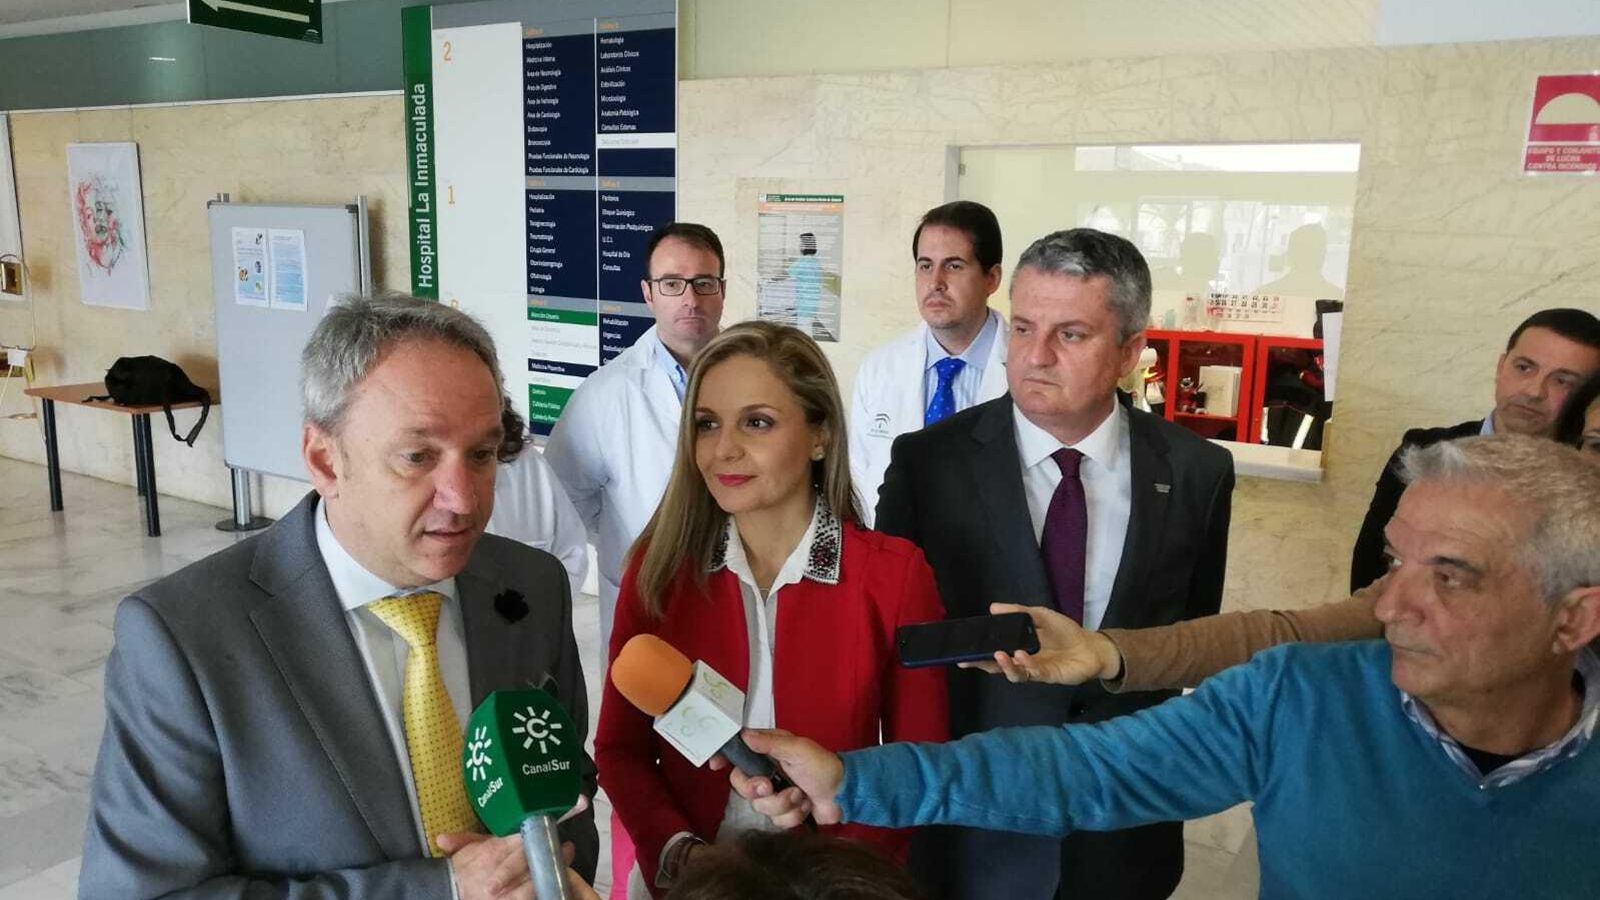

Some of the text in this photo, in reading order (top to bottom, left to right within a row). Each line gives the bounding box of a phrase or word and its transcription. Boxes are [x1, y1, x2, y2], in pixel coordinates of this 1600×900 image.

[443, 41, 452, 62] 2
[412, 83, 434, 288] Hospital La Inmaculada
[448, 184, 456, 205] 1
